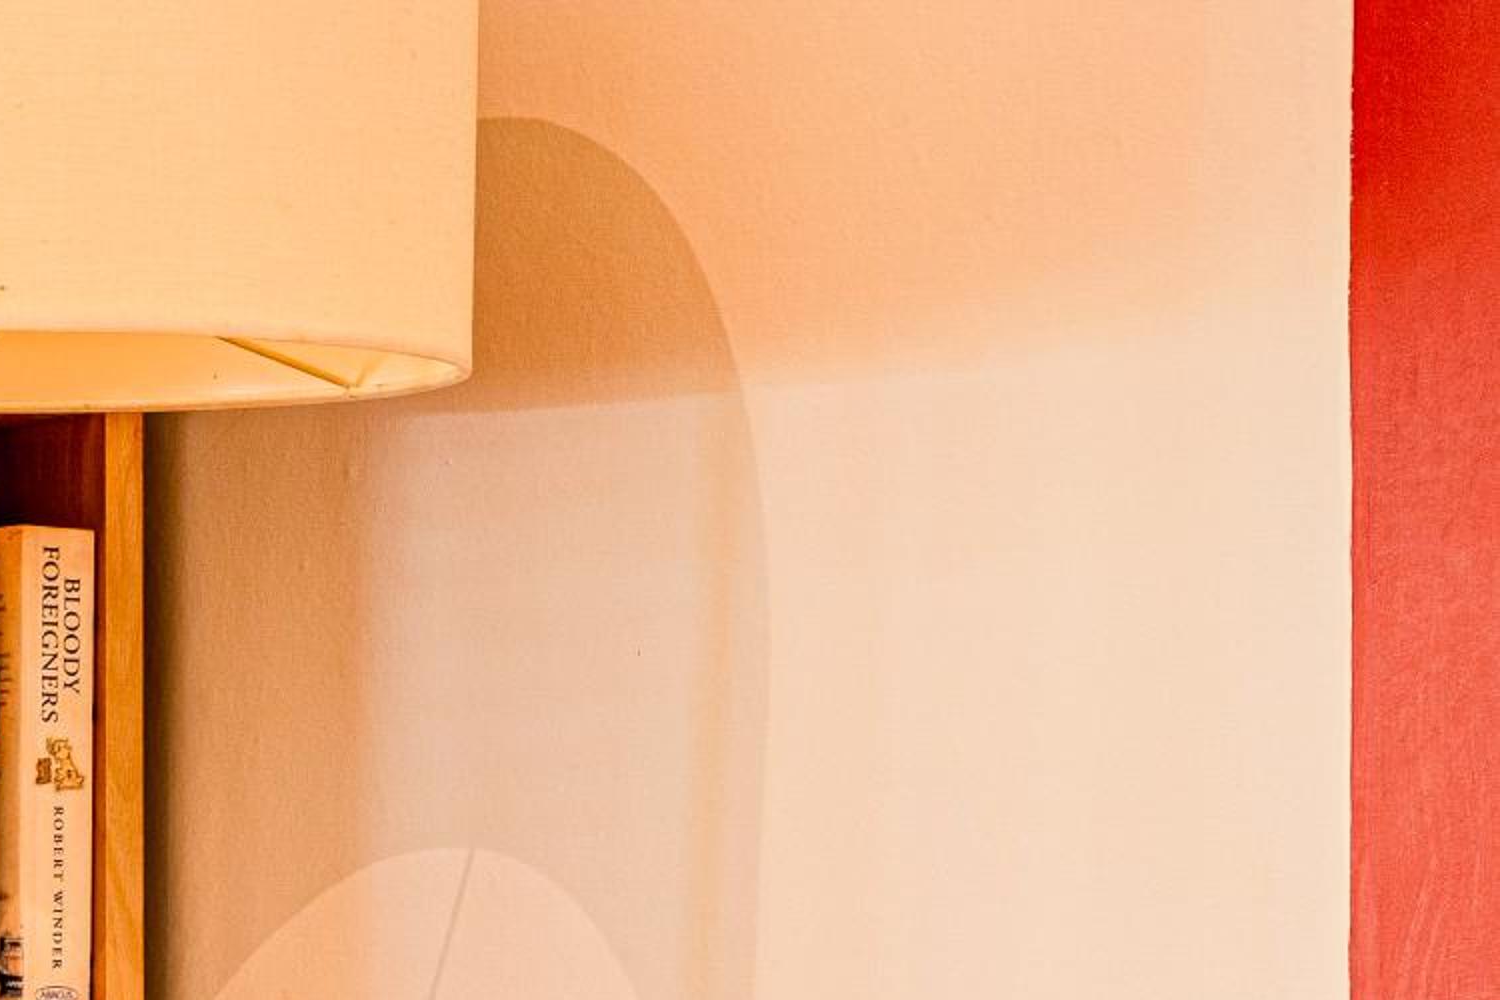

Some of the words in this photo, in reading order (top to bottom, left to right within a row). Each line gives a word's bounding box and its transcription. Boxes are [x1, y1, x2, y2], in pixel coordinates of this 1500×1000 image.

[41, 546, 60, 724] FOREIGNERS
[63, 578, 82, 694] BLOODY
[52, 805, 65, 881] ROBERT
[51, 891, 65, 970] WINDER
